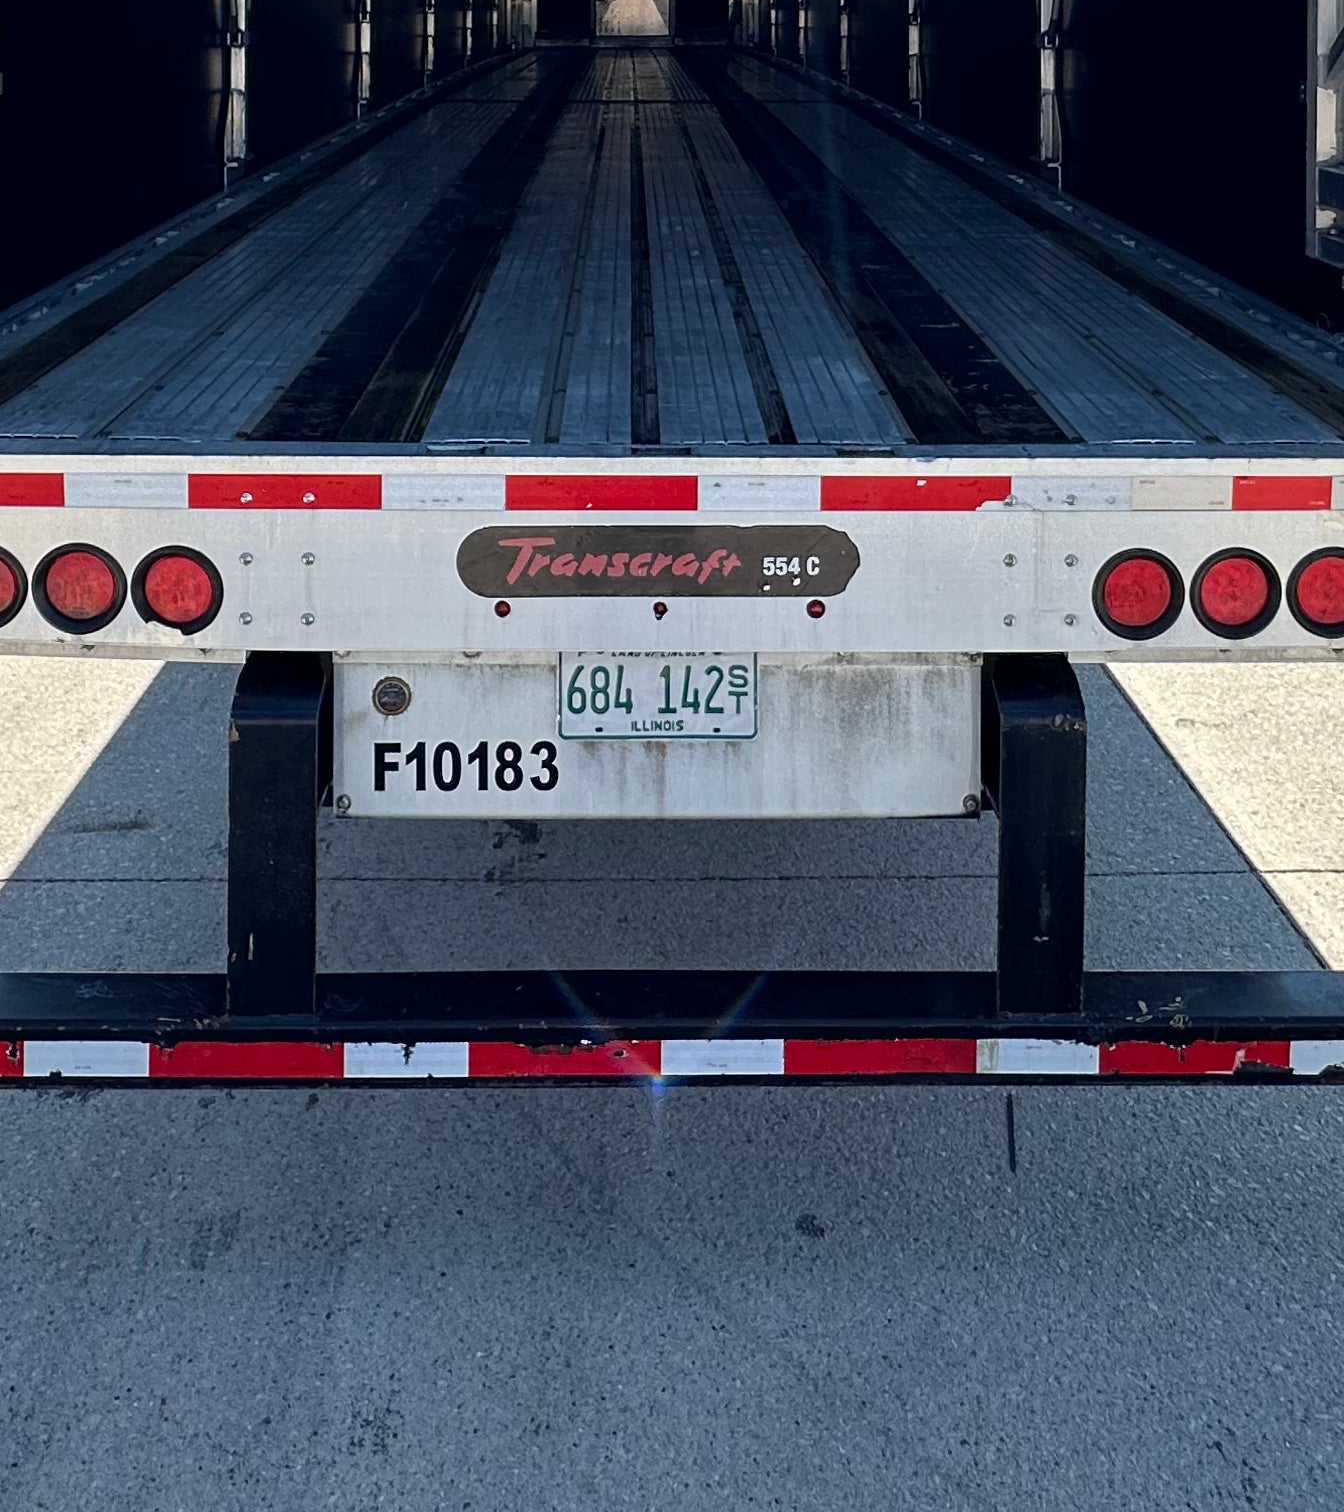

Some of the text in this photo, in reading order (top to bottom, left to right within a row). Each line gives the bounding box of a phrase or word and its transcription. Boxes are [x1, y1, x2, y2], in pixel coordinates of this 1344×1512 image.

[498, 536, 743, 584] Transcraft
[762, 556, 801, 577] 554
[567, 664, 634, 714] 684
[657, 664, 724, 714] 142
[631, 720, 684, 732] ILLINOIS
[374, 741, 559, 791] F10183
